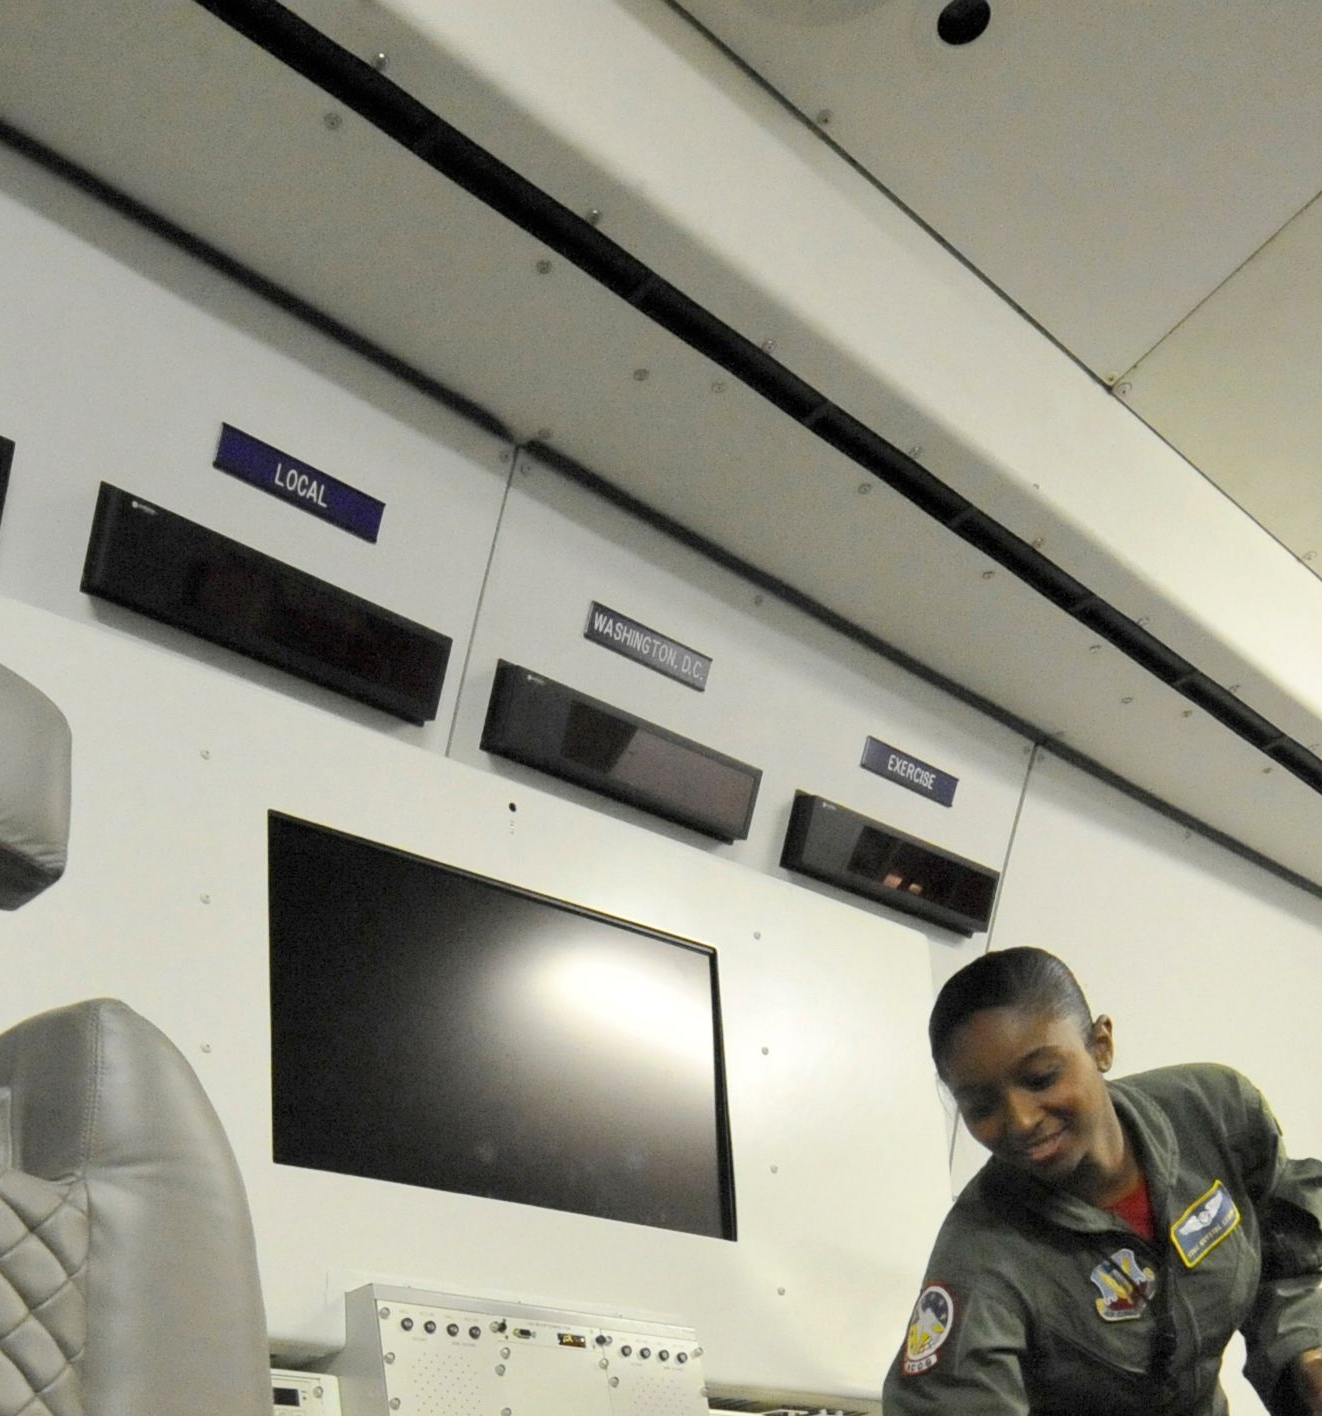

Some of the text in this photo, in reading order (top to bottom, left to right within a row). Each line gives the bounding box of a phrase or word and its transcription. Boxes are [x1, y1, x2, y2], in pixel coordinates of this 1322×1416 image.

[274, 463, 328, 508] LOCAL
[681, 655, 704, 681] D.C.
[887, 754, 936, 790] EXERCISE
